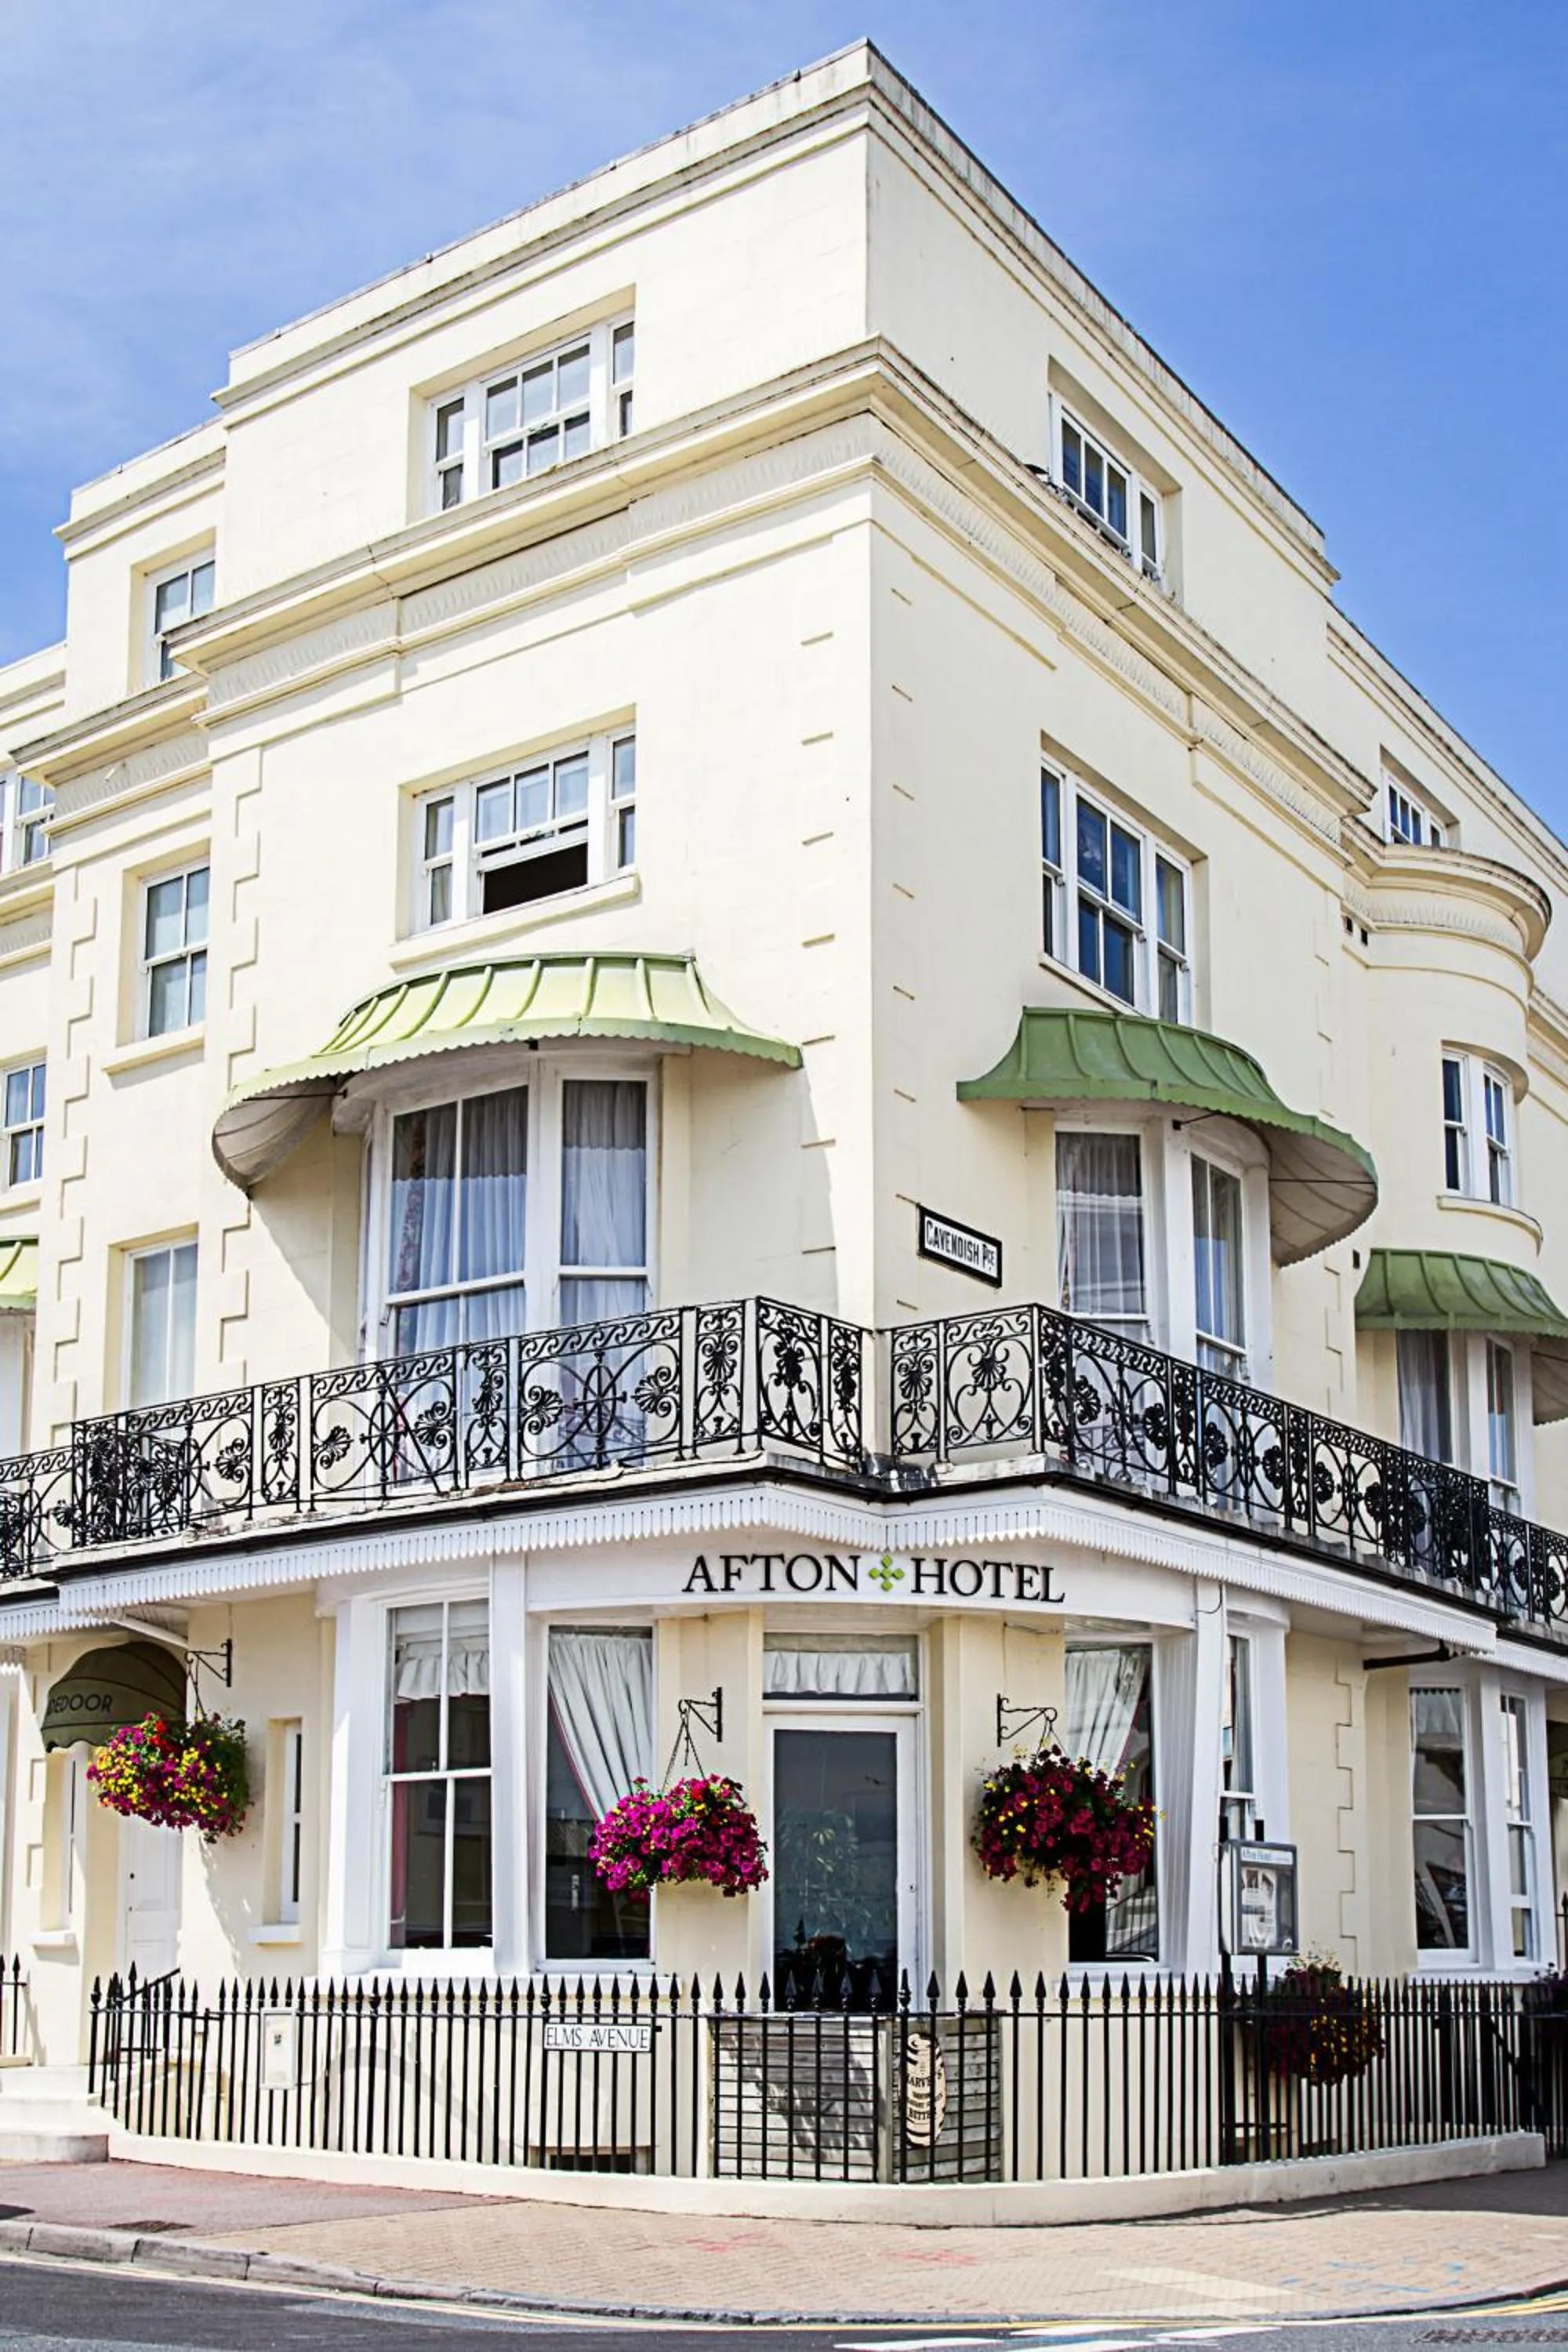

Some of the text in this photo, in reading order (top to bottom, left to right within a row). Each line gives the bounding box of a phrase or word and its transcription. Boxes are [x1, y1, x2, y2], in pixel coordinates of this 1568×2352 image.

[926, 1219, 979, 1265] CAVENDISH
[682, 1553, 1065, 1603] AFTON HOTEL
[546, 2027, 648, 2049] ELMS AVENUE
